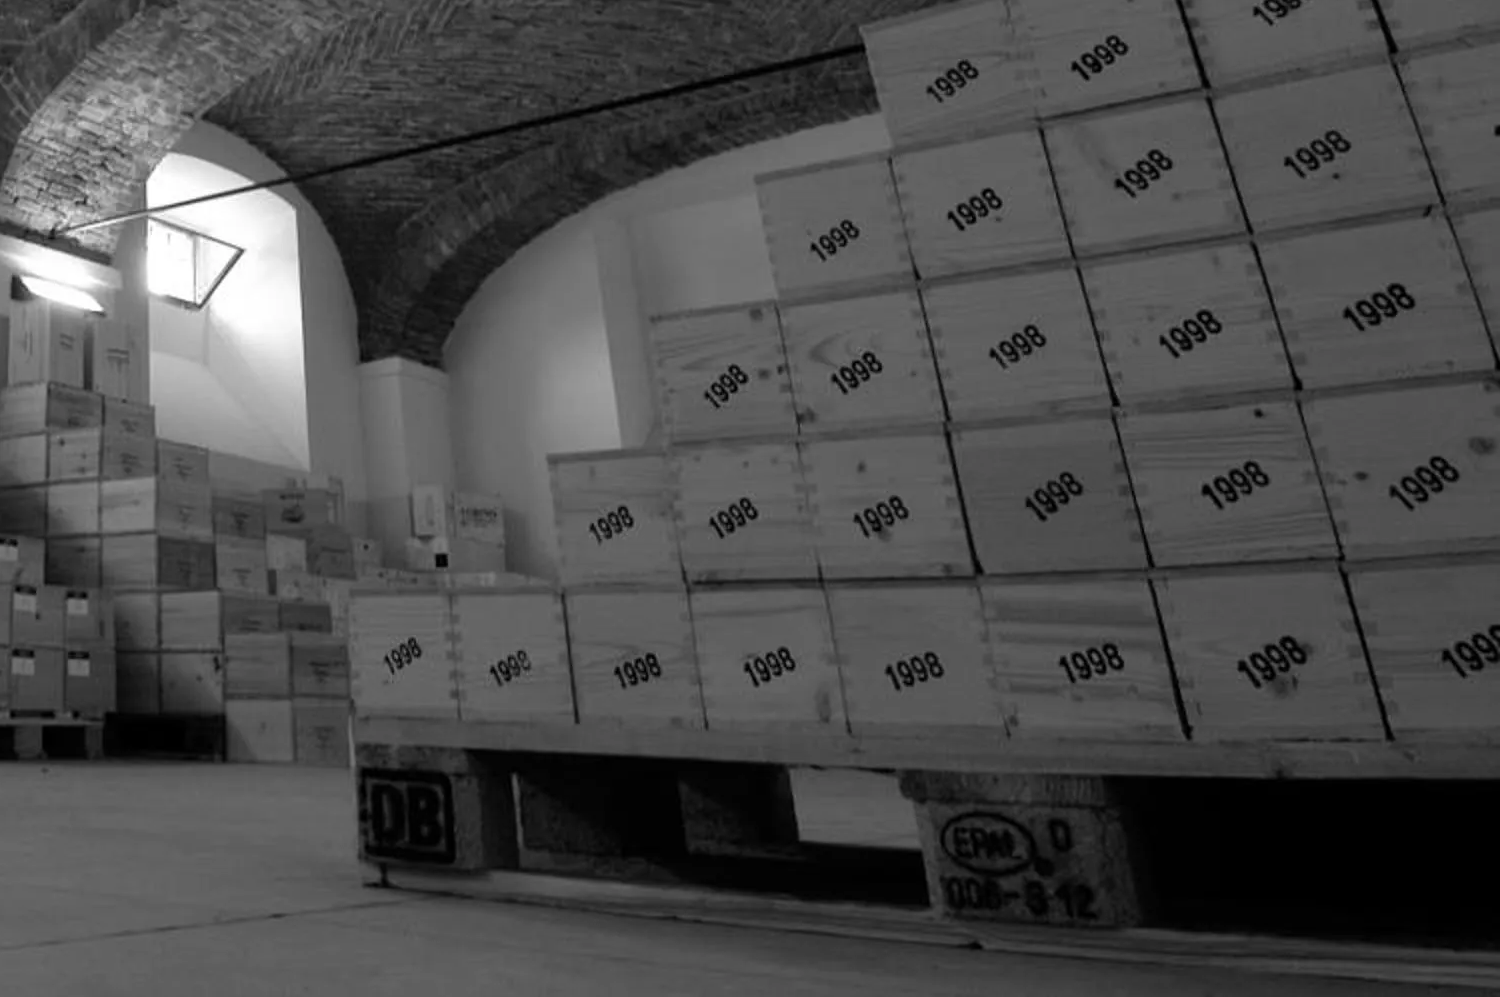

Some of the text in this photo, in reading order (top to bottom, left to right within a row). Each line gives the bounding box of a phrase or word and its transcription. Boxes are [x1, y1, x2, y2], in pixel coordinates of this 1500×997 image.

[1070, 34, 1129, 81] 1998
[926, 59, 980, 103] 1998
[1113, 149, 1174, 198] 1998
[1283, 129, 1352, 180] 1998
[947, 187, 1003, 232] 1998
[810, 219, 860, 262] 1998
[1342, 283, 1416, 332] 1998
[989, 324, 1047, 369] 1998
[1159, 309, 1223, 359] 1998
[703, 364, 749, 409] 1998
[831, 351, 883, 395] 1998
[1025, 471, 1084, 522] 1998
[1201, 460, 1270, 510] 1998
[1389, 455, 1460, 511] 1998
[589, 505, 635, 544] 1998
[709, 497, 759, 540] 1998
[853, 495, 909, 538] 1998
[383, 637, 423, 676] 1998
[489, 650, 531, 687] 1998
[613, 652, 662, 689] 1998
[743, 646, 796, 688] 1998
[885, 651, 945, 691] 1998
[1059, 642, 1125, 684] 1998
[1237, 635, 1308, 689] 1998
[371, 782, 443, 848] DB
